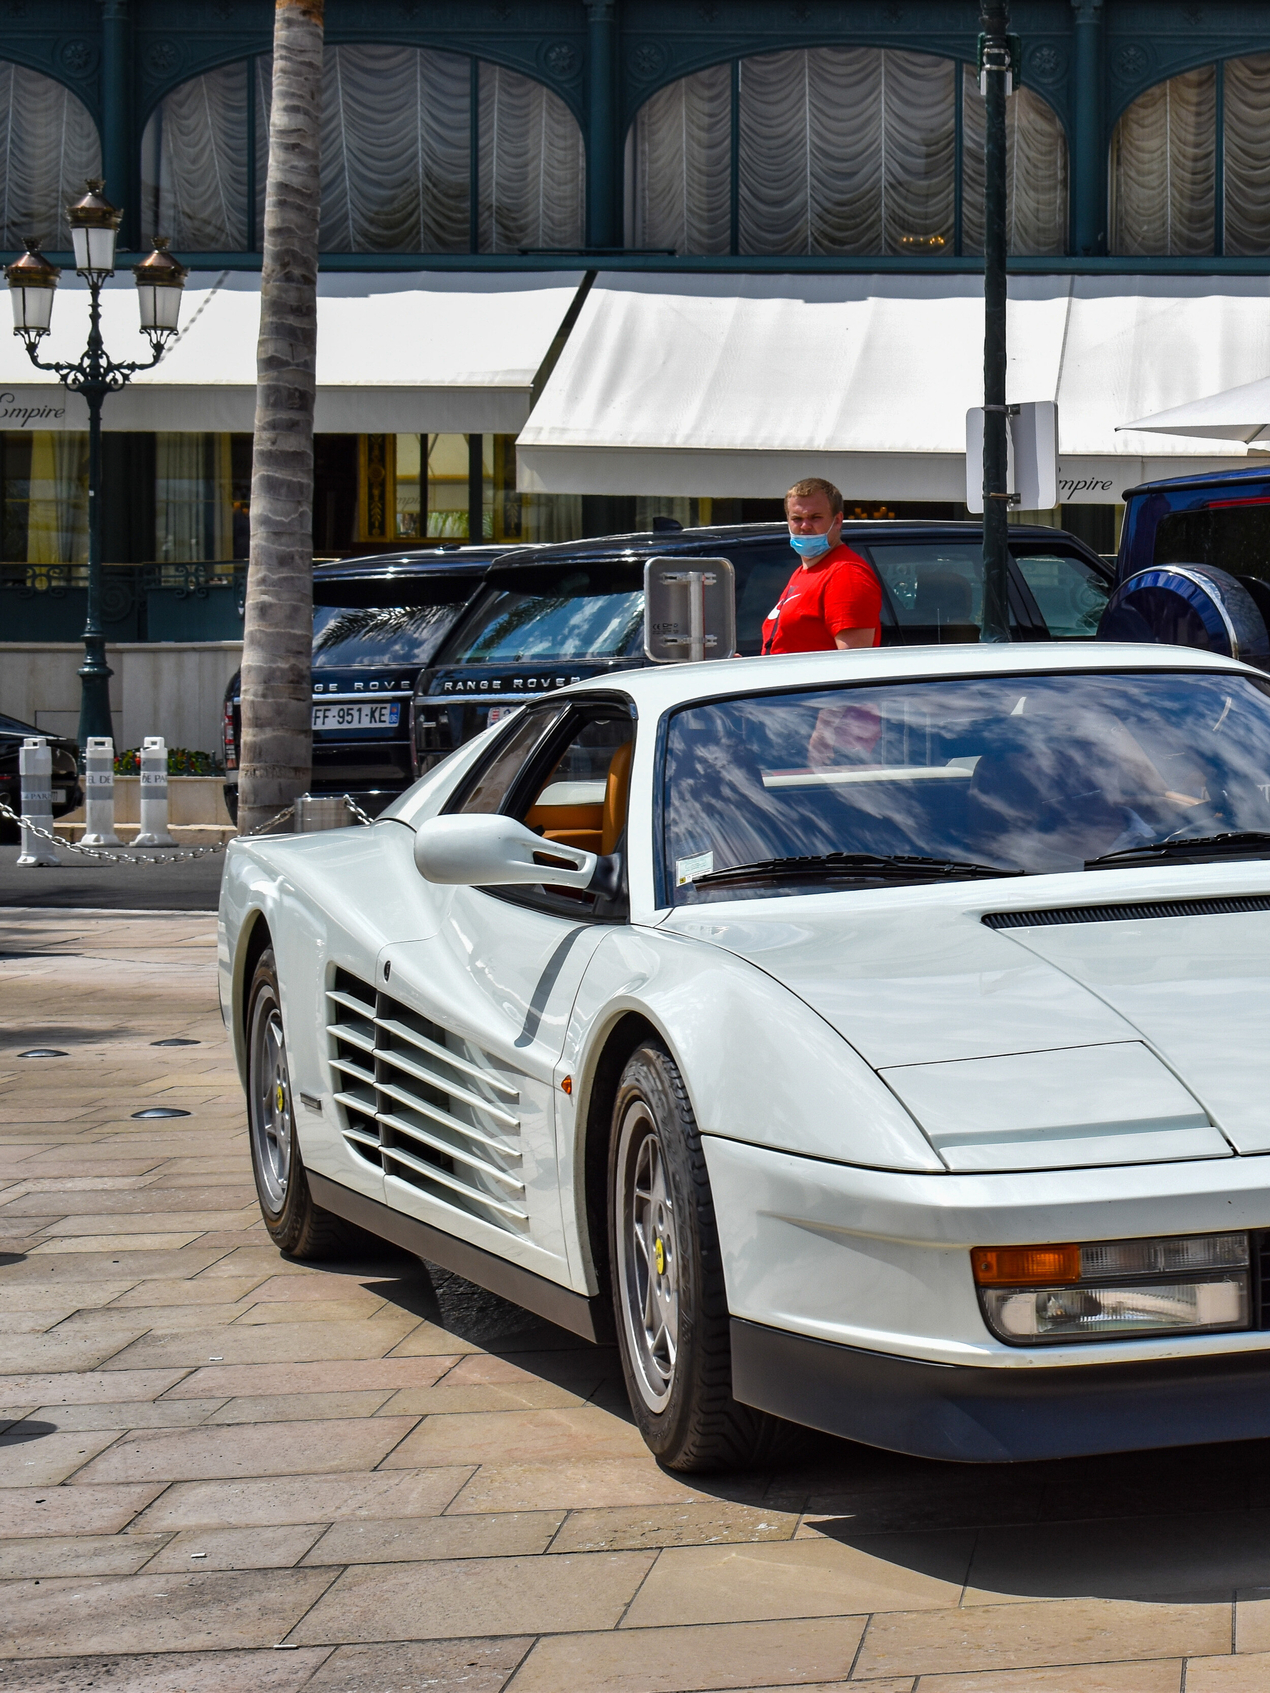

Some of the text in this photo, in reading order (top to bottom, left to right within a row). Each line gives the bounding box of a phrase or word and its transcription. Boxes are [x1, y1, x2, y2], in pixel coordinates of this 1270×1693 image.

[1058, 468, 1113, 500] mpire
[354, 681, 410, 690] ROVE
[444, 680, 501, 691] RANGE
[313, 706, 387, 726] FF-951-KE
